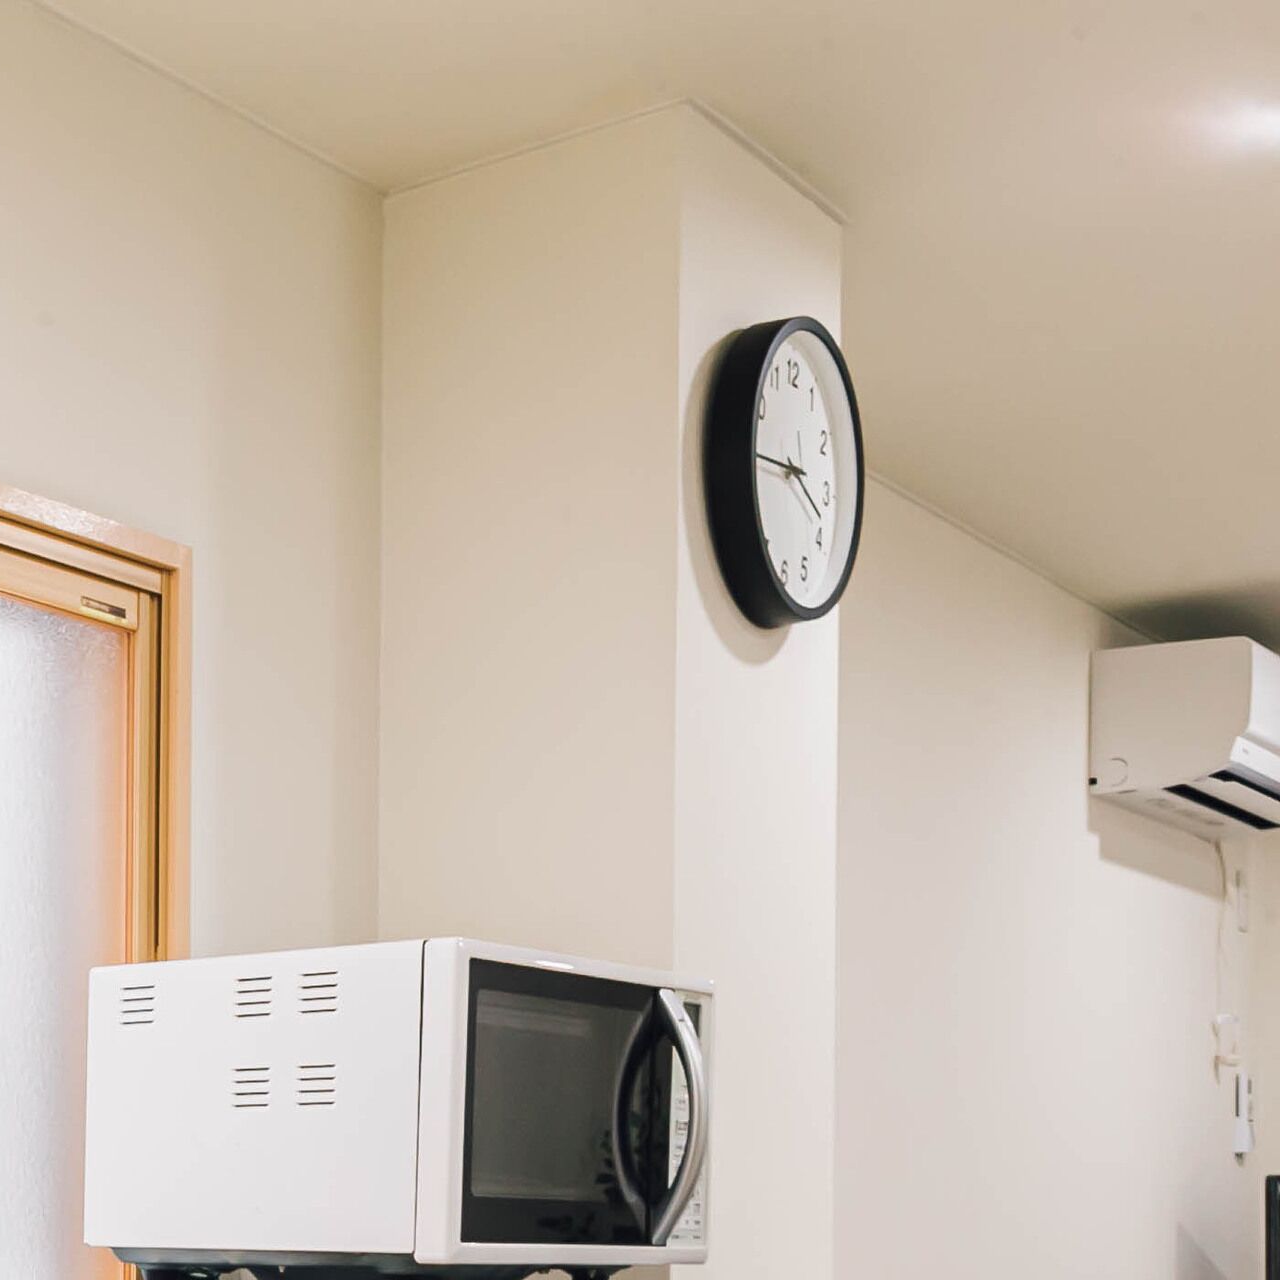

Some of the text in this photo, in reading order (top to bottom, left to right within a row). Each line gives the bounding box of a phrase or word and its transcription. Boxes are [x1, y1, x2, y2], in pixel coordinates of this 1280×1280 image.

[787, 359, 799, 389] 12
[810, 386, 814, 412] 1
[821, 430, 828, 456] 2
[823, 481, 829, 507] 3
[816, 527, 822, 551] 4
[800, 556, 808, 582] 5
